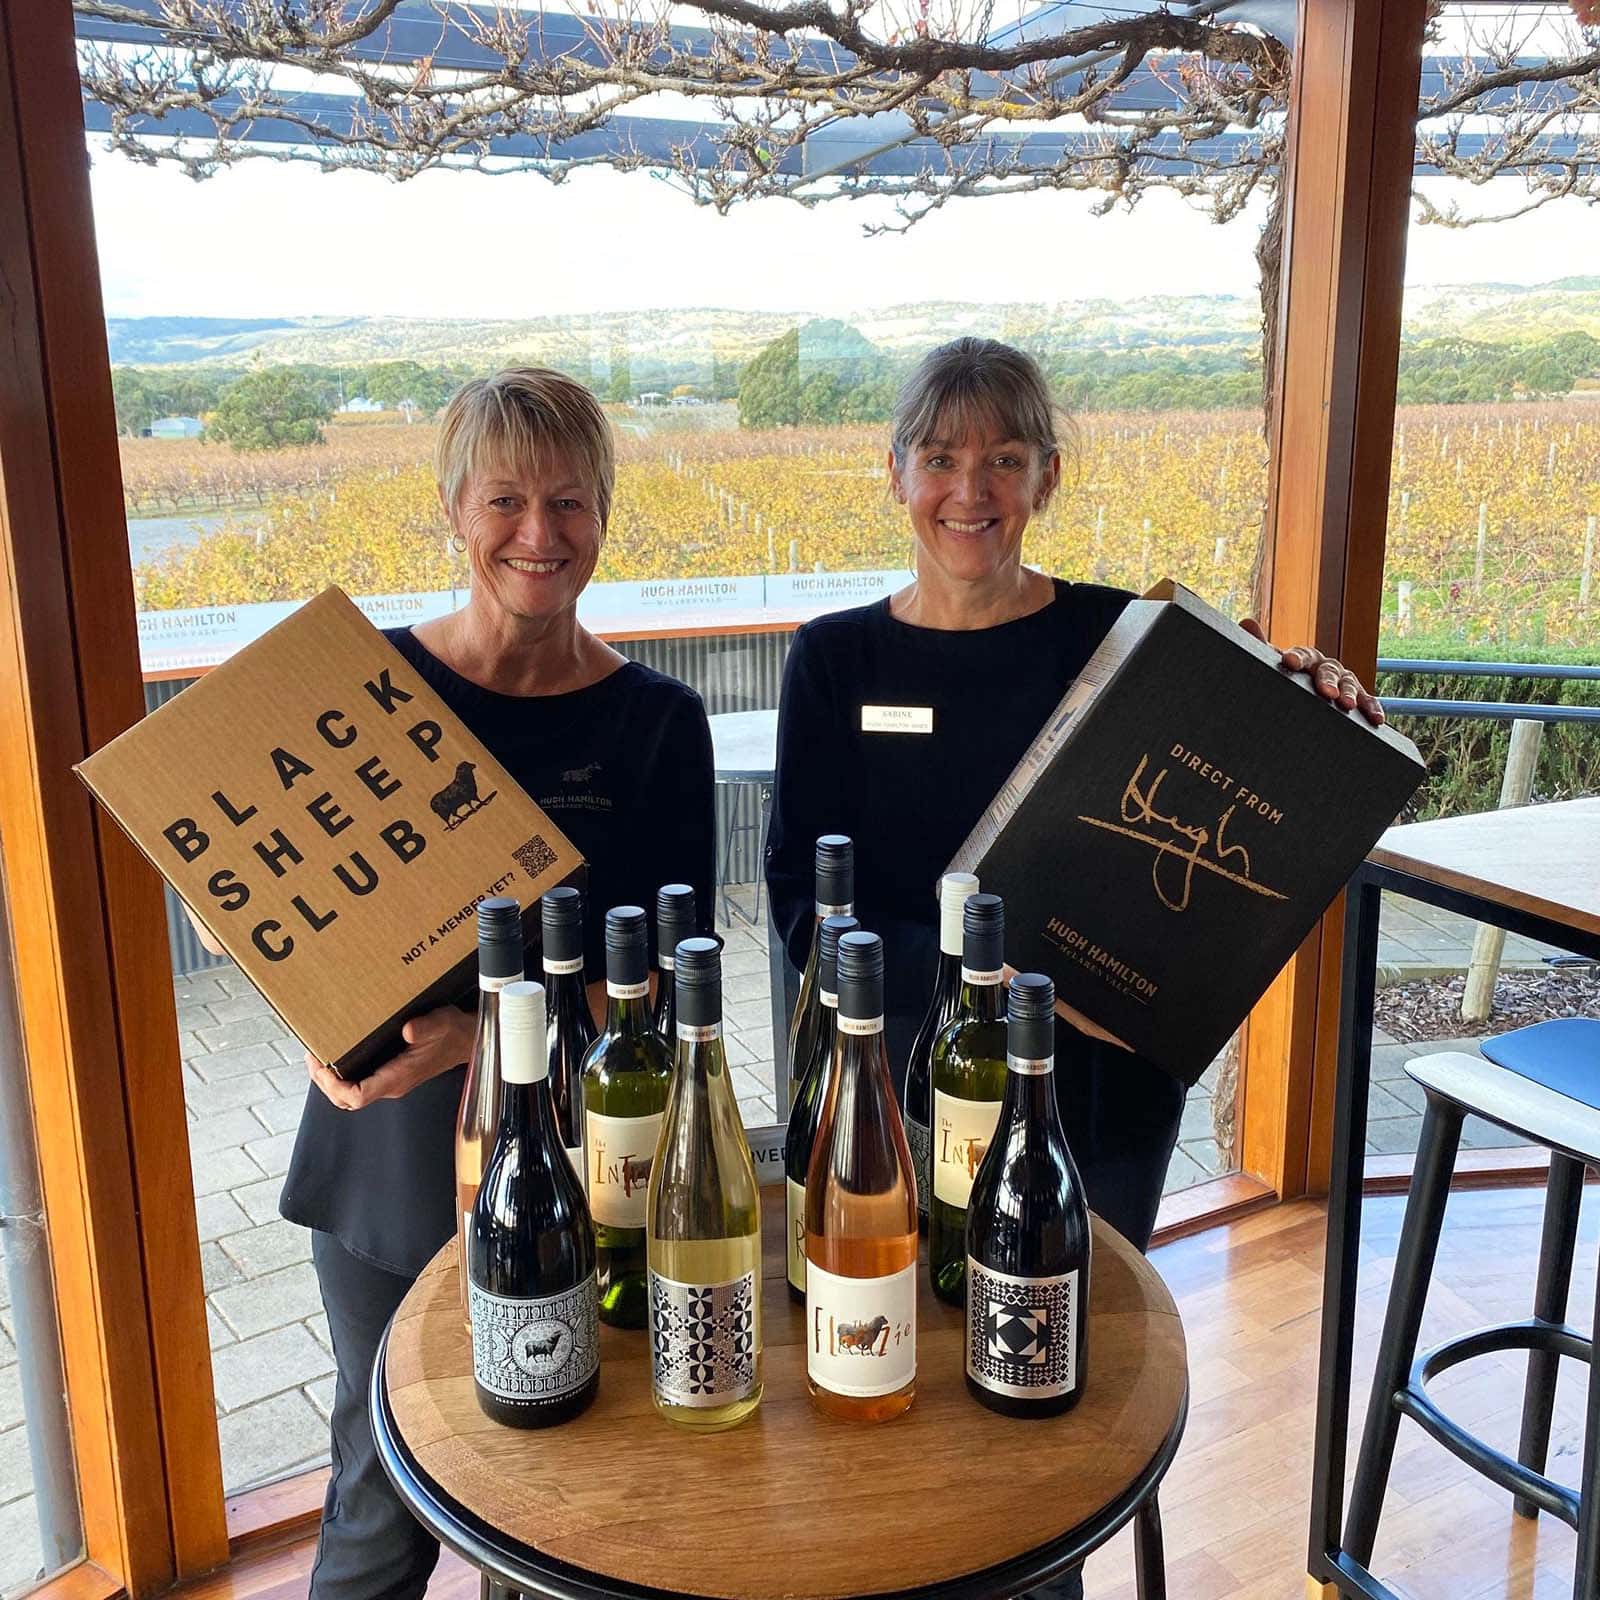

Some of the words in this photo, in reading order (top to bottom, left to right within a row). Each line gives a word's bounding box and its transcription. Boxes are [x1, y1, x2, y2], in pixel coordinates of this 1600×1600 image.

[162, 611, 237, 630] HAMILTON
[640, 585, 675, 599] HUGH
[677, 582, 737, 597] HAMILTON
[792, 578, 826, 591] HUGH
[827, 575, 886, 589] HAMILTON
[163, 668, 415, 864] BLACK
[567, 795, 613, 808] HAMILTON
[1169, 743, 1235, 791] DIRECT
[1234, 786, 1285, 826] FROM
[207, 719, 443, 912] SHEEP
[251, 819, 427, 962] CLUB
[401, 941, 428, 966] NOT
[428, 934, 440, 947] A
[436, 894, 487, 937] MEMBER
[486, 871, 516, 898] YET?
[1046, 917, 1089, 951] HUGH
[1086, 944, 1159, 998] HAMILTON
